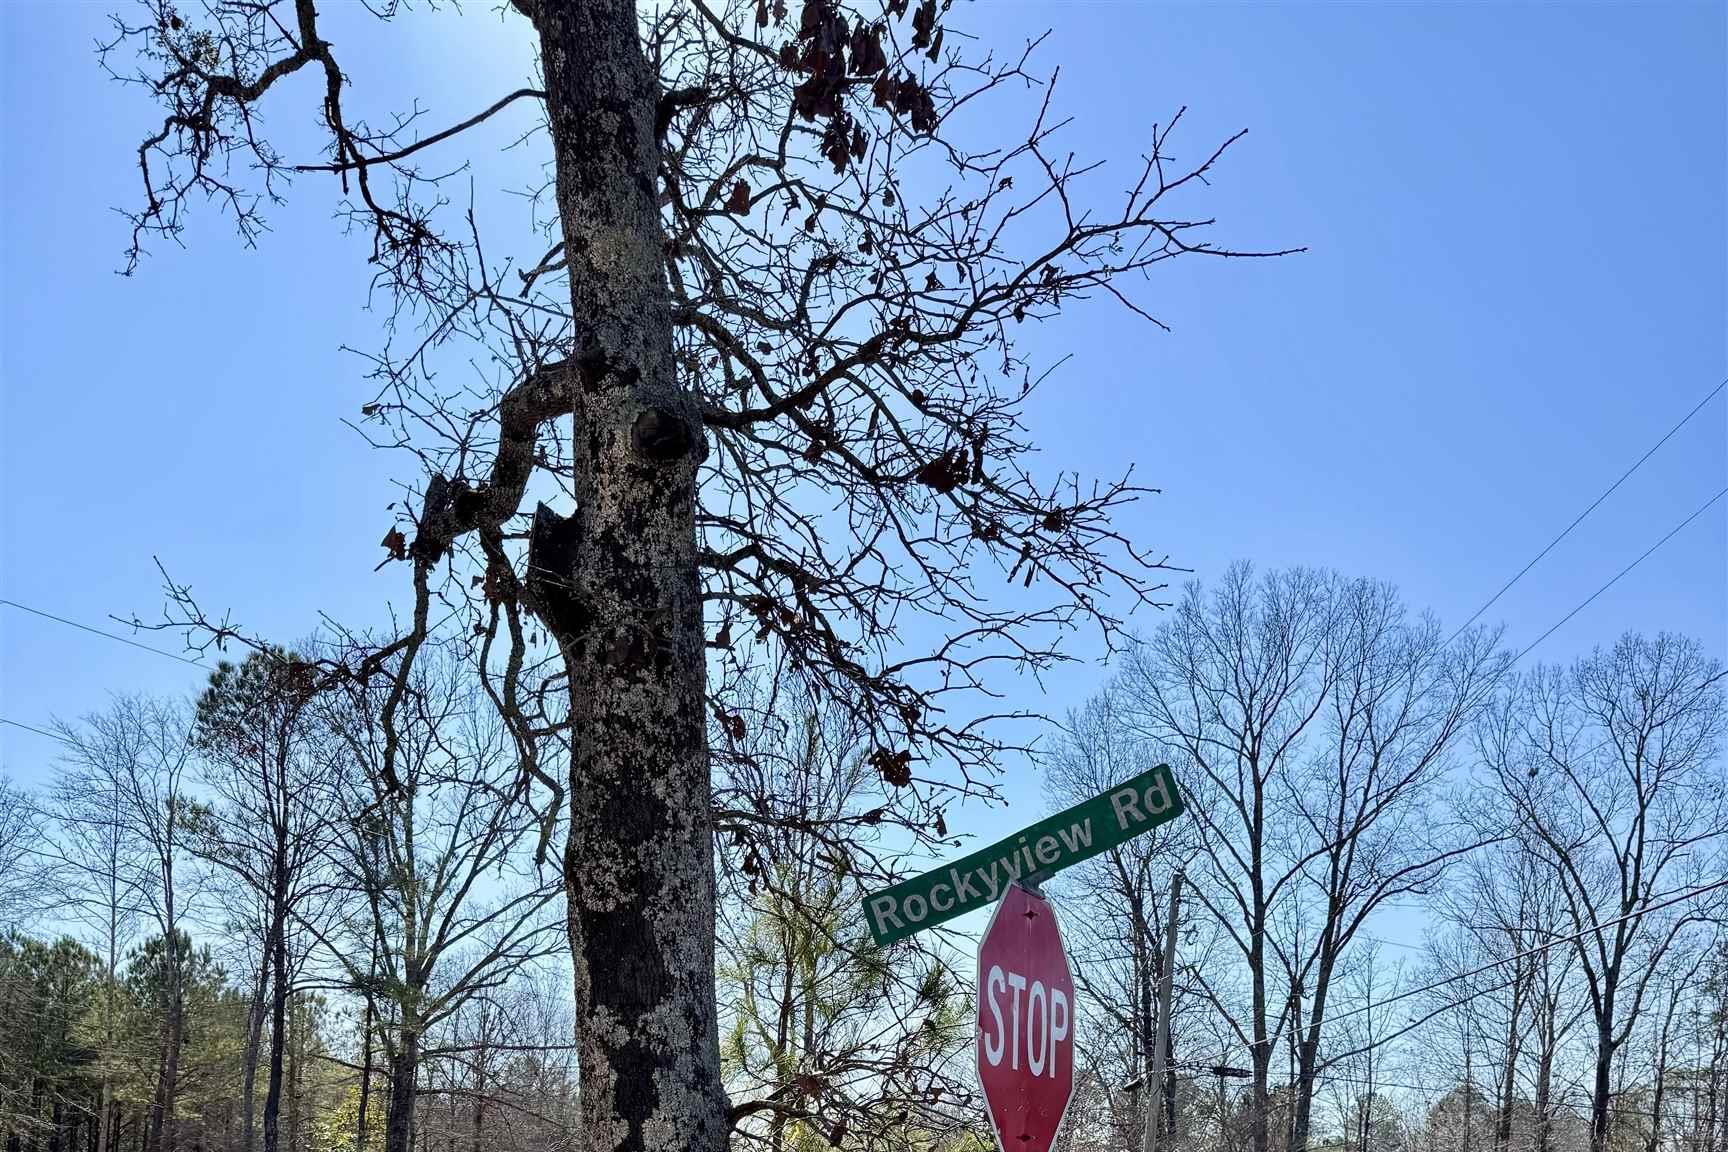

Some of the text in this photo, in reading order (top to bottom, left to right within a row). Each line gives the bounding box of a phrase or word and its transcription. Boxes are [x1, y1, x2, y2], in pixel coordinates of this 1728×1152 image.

[869, 772, 1174, 936] Rockyview Rd
[985, 965, 1069, 1079] STOP
